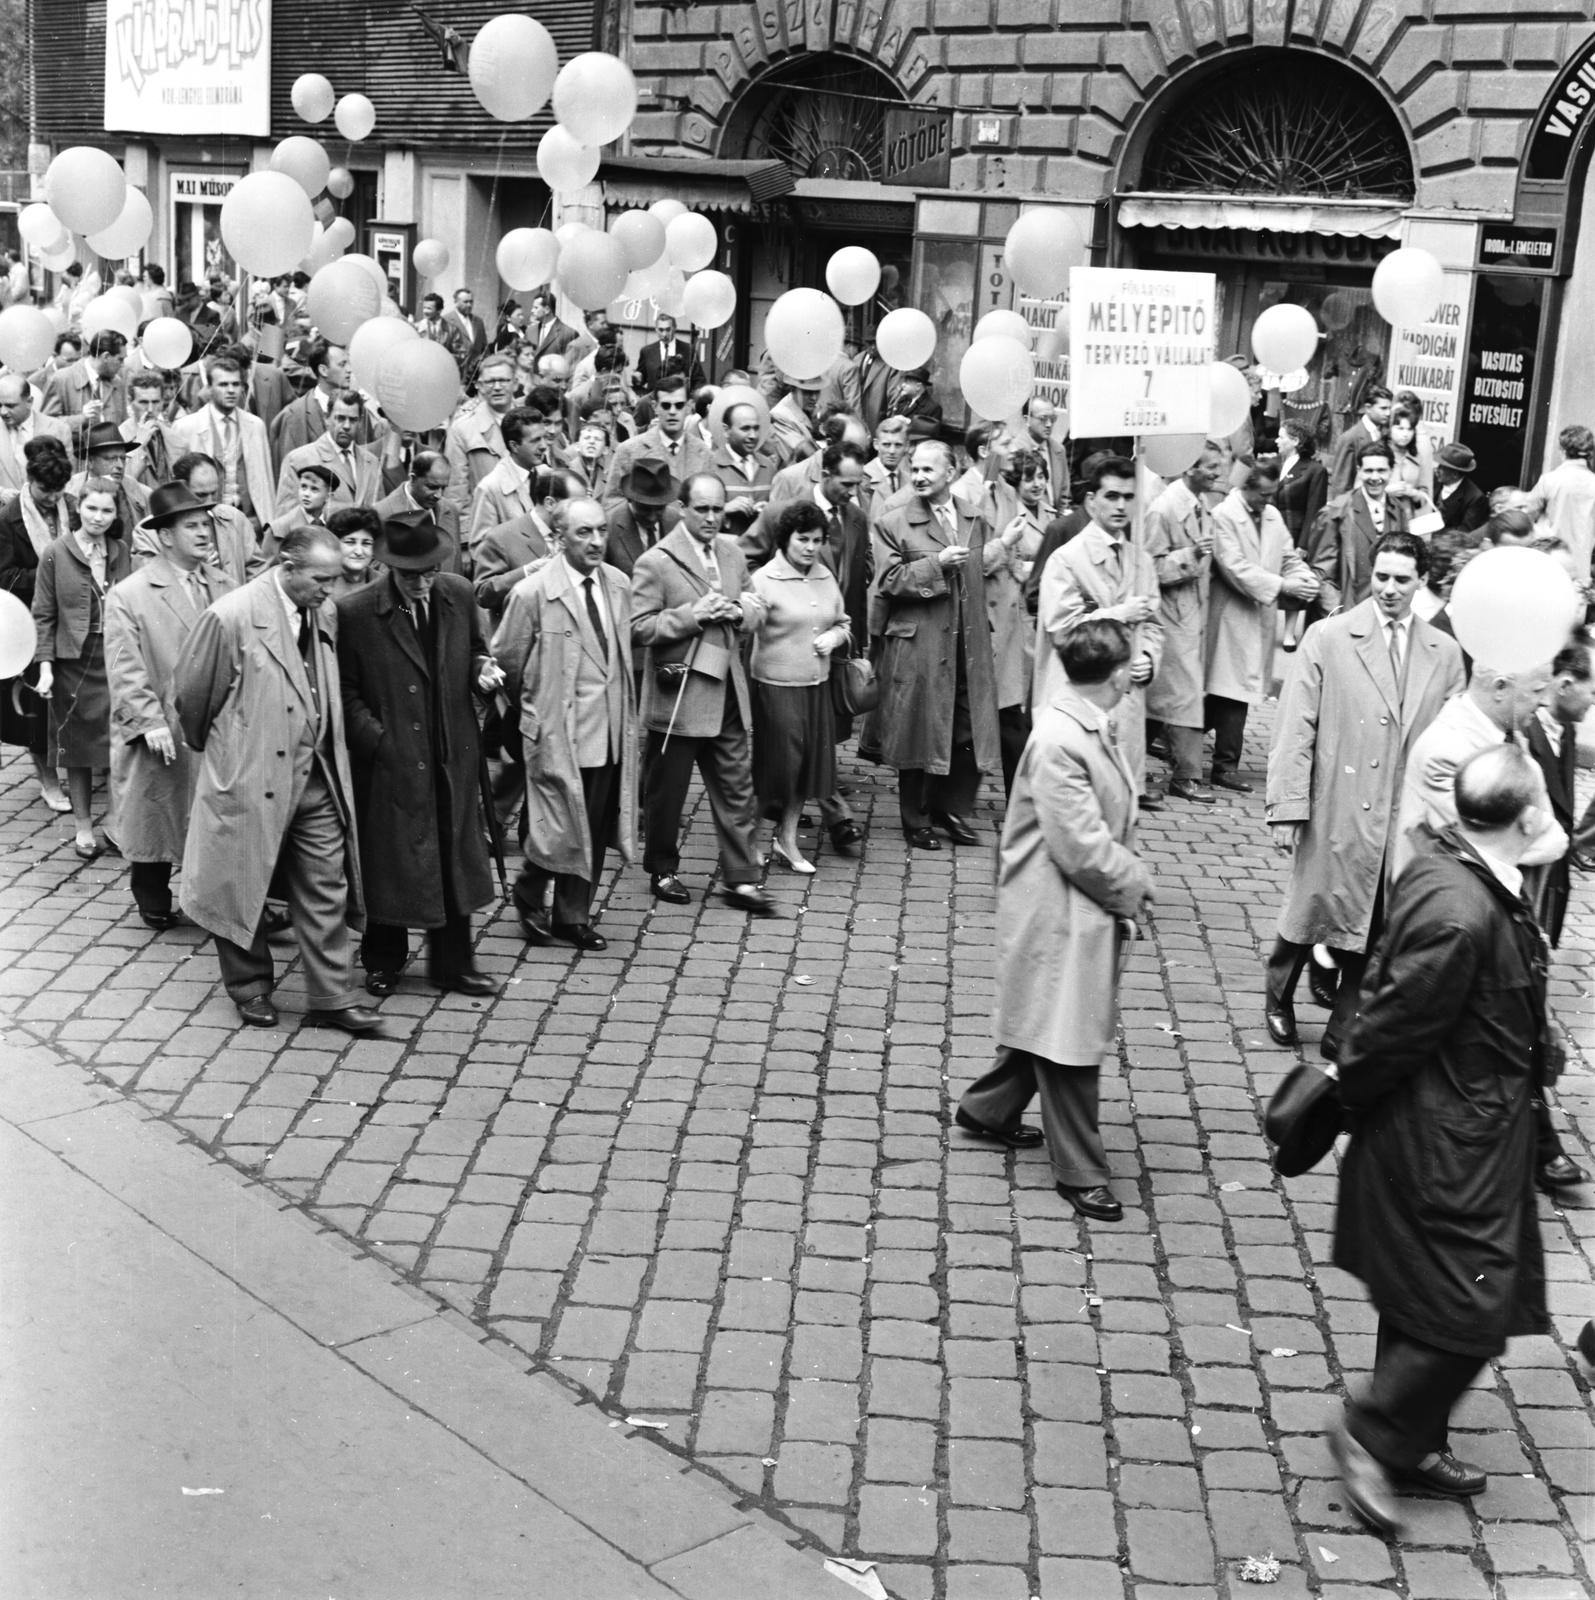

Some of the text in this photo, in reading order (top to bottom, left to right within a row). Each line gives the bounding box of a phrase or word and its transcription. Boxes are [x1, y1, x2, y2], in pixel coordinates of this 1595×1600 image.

[1544, 52, 1595, 137] VASU
[887, 117, 948, 178] KÖTÖDE
[176, 179, 196, 196] MAI
[1515, 240, 1553, 257] EMELETEN
[1481, 350, 1524, 374] VASUTAS
[1143, 369, 1154, 399] 7
[1397, 364, 1455, 392] KULIKABÁT
[1473, 377, 1525, 401] BIZTOSITÓ
[1468, 403, 1524, 428] EGYESÜLET
